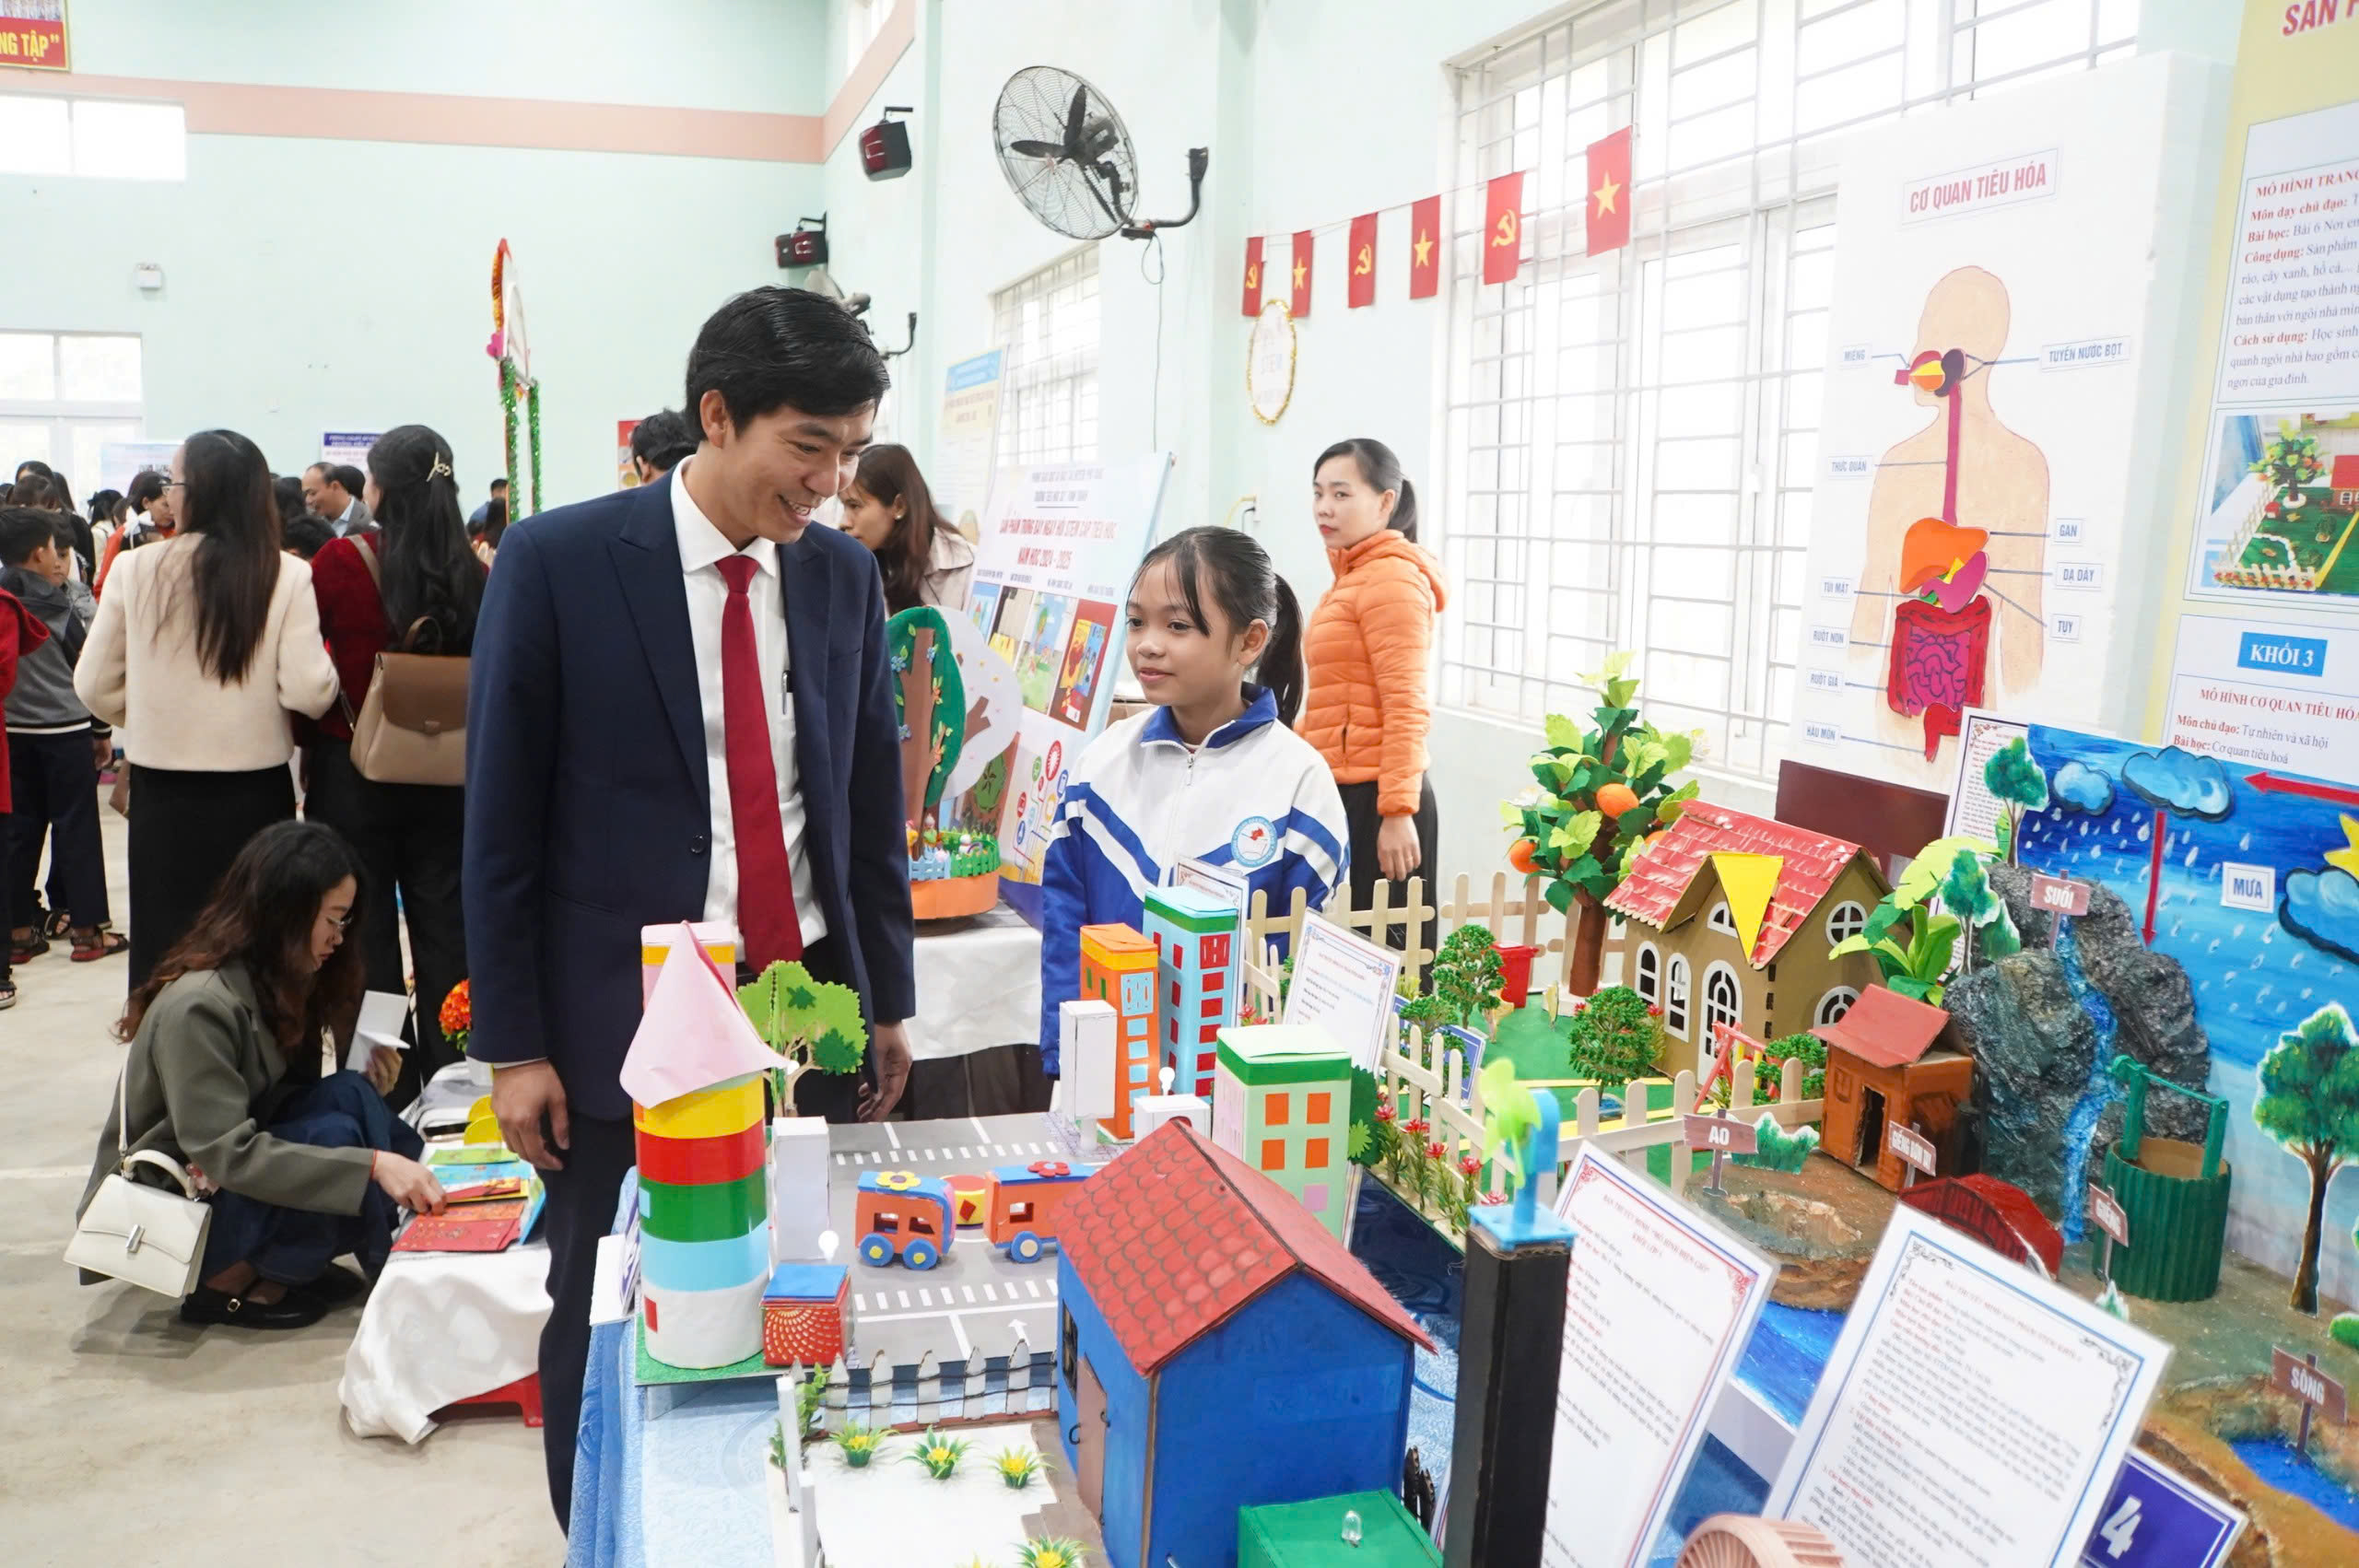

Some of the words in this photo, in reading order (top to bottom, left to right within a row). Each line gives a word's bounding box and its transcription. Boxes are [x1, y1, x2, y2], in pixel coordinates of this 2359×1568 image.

[1910, 187, 1930, 213] CƠ
[1932, 180, 1972, 209] QUAN
[1977, 170, 2010, 199] TIÊU
[2014, 160, 2047, 192] HÓA
[2257, 181, 2277, 197] MÔ
[2281, 177, 2313, 193] HÌNH
[2251, 210, 2274, 222] Môn
[2278, 207, 2295, 219] dạy
[2248, 230, 2265, 243] Bài
[2268, 228, 2290, 241] học:
[2245, 251, 2272, 264] Công
[2273, 248, 2304, 262] dụng:
[2273, 289, 2298, 303] dụng
[2234, 333, 2259, 346] Cách
[2277, 332, 2308, 345] dụng:
[2311, 327, 2333, 343] Học
[2230, 354, 2259, 369] quanh
[2305, 350, 2323, 363] bao
[2059, 523, 2077, 537] GAN
[2250, 642, 2300, 666] KHỐI
[2303, 649, 2314, 668] 3
[2200, 687, 2218, 702] MÔ
[2220, 689, 2248, 706] HÌNH
[2250, 696, 2268, 708] CƠ
[2269, 698, 2302, 714] QUAN
[2306, 701, 2334, 719] TIÊU
[2177, 714, 2198, 729] Môn
[2218, 721, 2240, 736] đạo:
[2258, 726, 2283, 742] nhiên
[2285, 730, 2297, 743] và
[2299, 731, 2311, 745] xã
[2312, 735, 2329, 749] hội
[2174, 733, 2189, 746] Bài
[2190, 736, 2211, 751] học:
[2212, 740, 2228, 753] Cơ
[2228, 745, 2250, 758] quan
[2251, 746, 2270, 761] tiêu
[2044, 884, 2074, 909] SUỐI
[2234, 878, 2263, 899] MƯA
[1708, 1125, 1731, 1146] AO
[2291, 1365, 2325, 1406] SÔNG
[2100, 1495, 2142, 1560] 4
